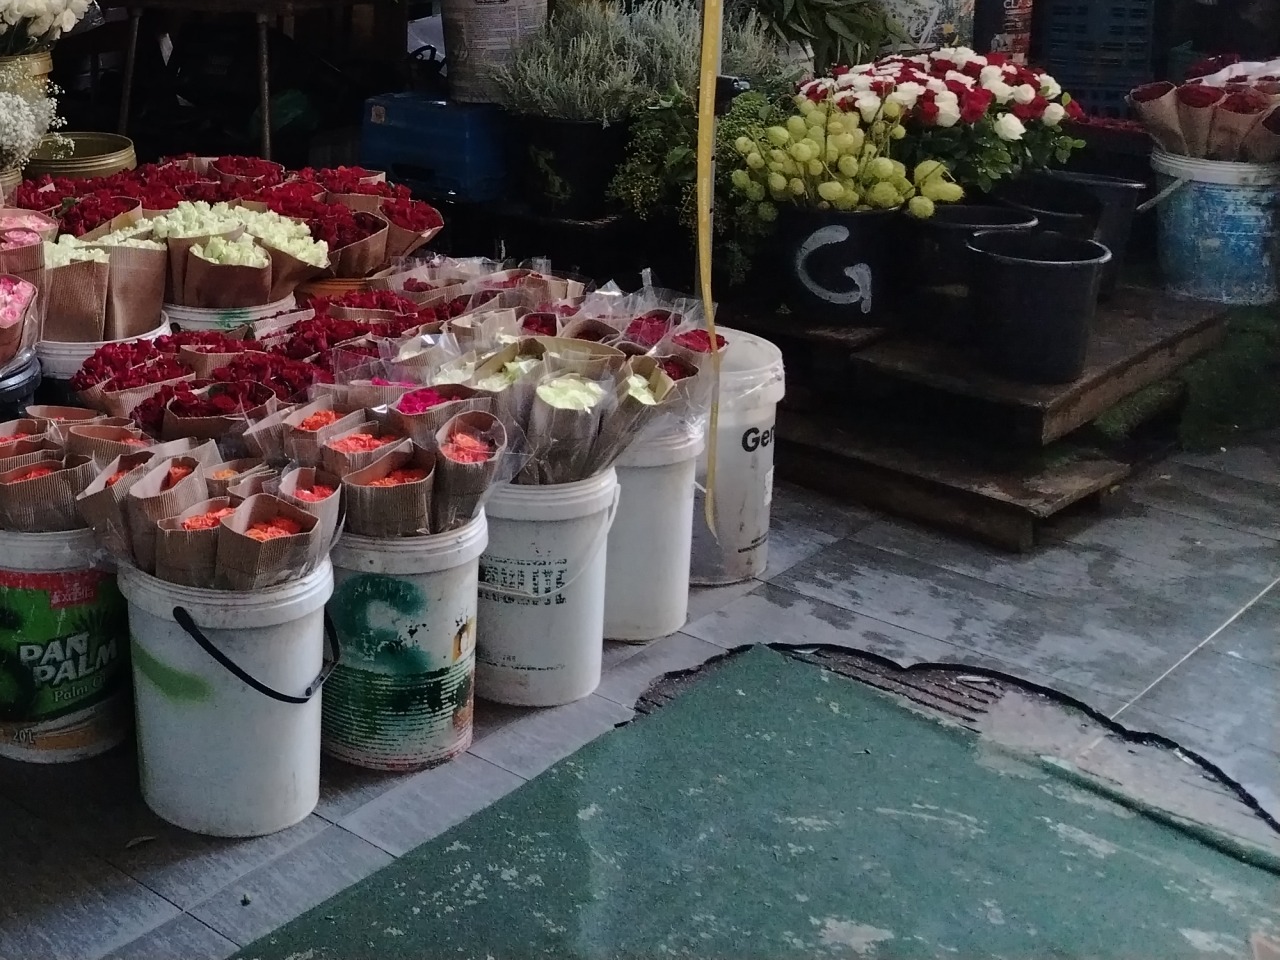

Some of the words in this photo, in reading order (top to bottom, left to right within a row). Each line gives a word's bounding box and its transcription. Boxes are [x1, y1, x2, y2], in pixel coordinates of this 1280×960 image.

[794, 224, 873, 314] G
[20, 631, 90, 665] PAN
[33, 638, 118, 686] PALM
[54, 686, 88, 702] Palm
